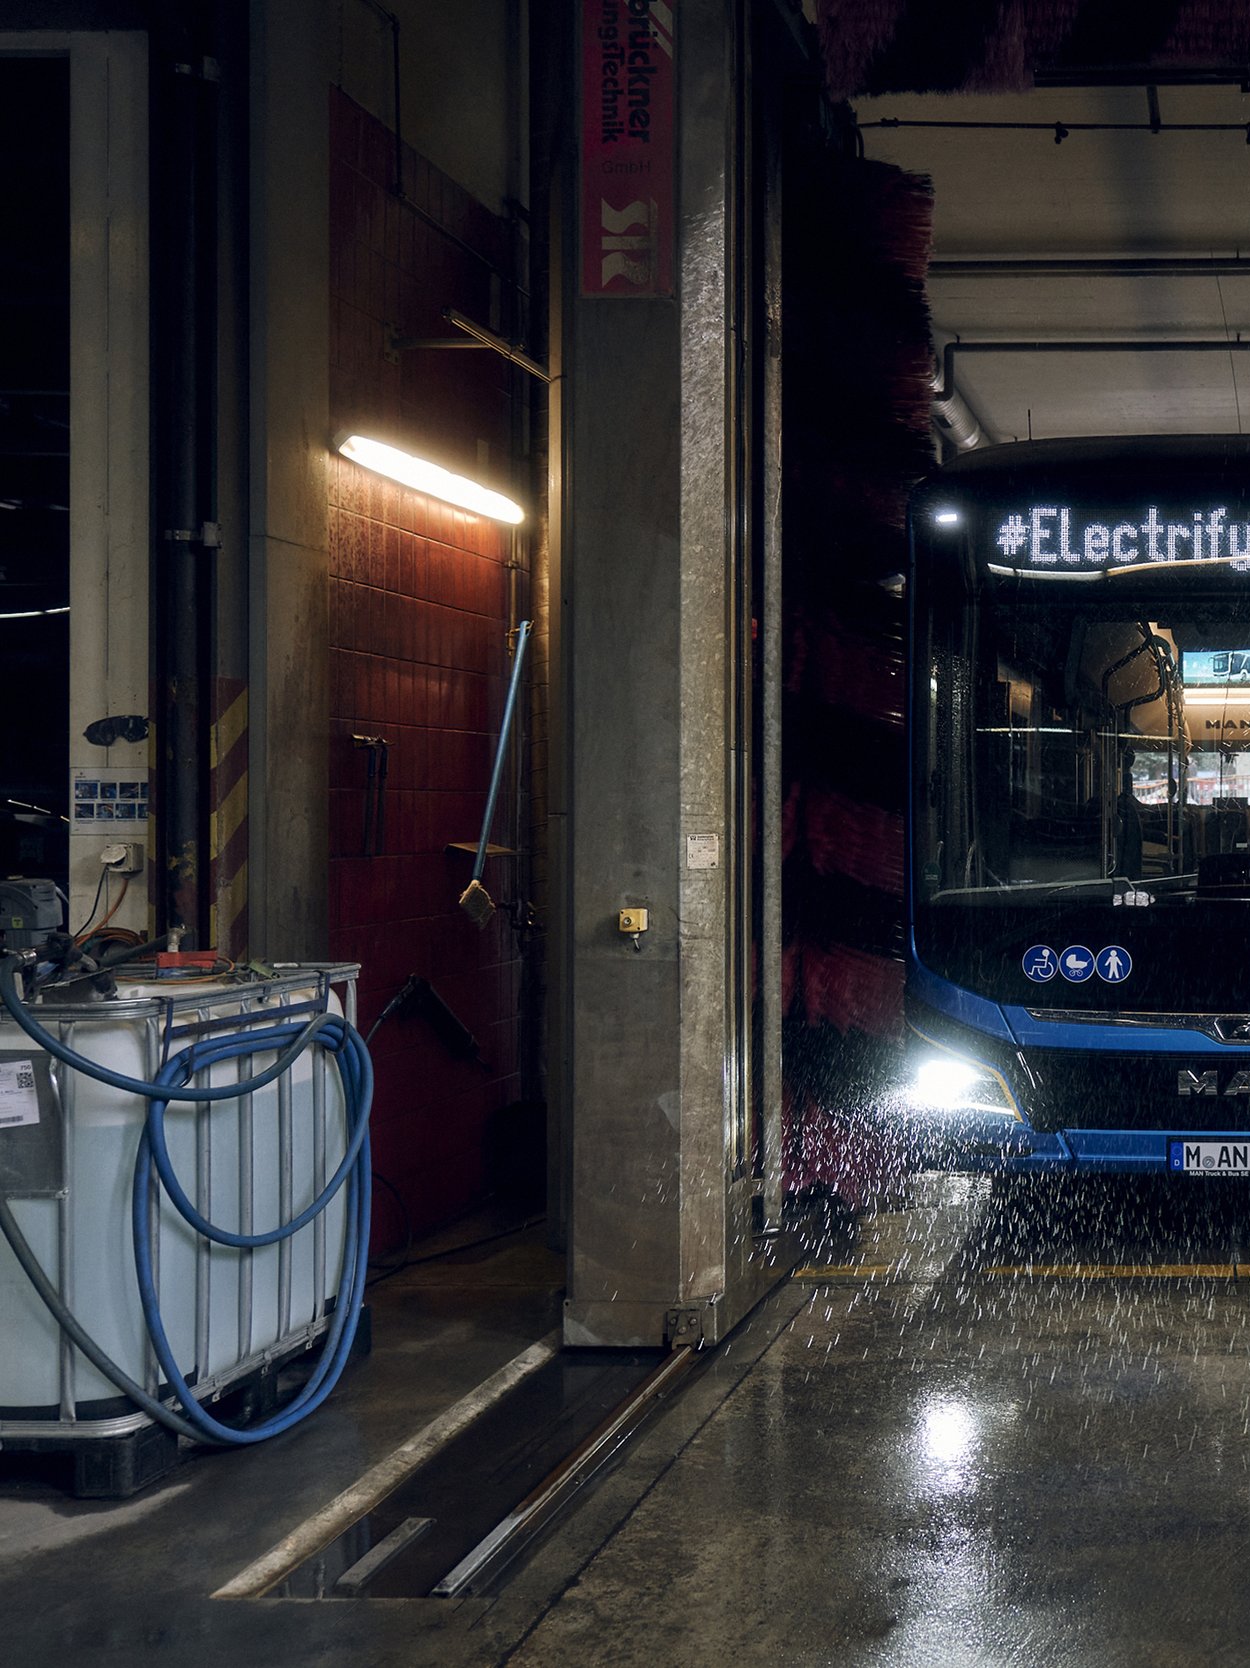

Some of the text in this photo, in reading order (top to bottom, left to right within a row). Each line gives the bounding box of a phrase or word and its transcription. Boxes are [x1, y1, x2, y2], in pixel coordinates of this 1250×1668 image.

[602, 160, 650, 174] GmbH
[1185, 1145, 1201, 1168] M
[1217, 1145, 1248, 1168] AN
